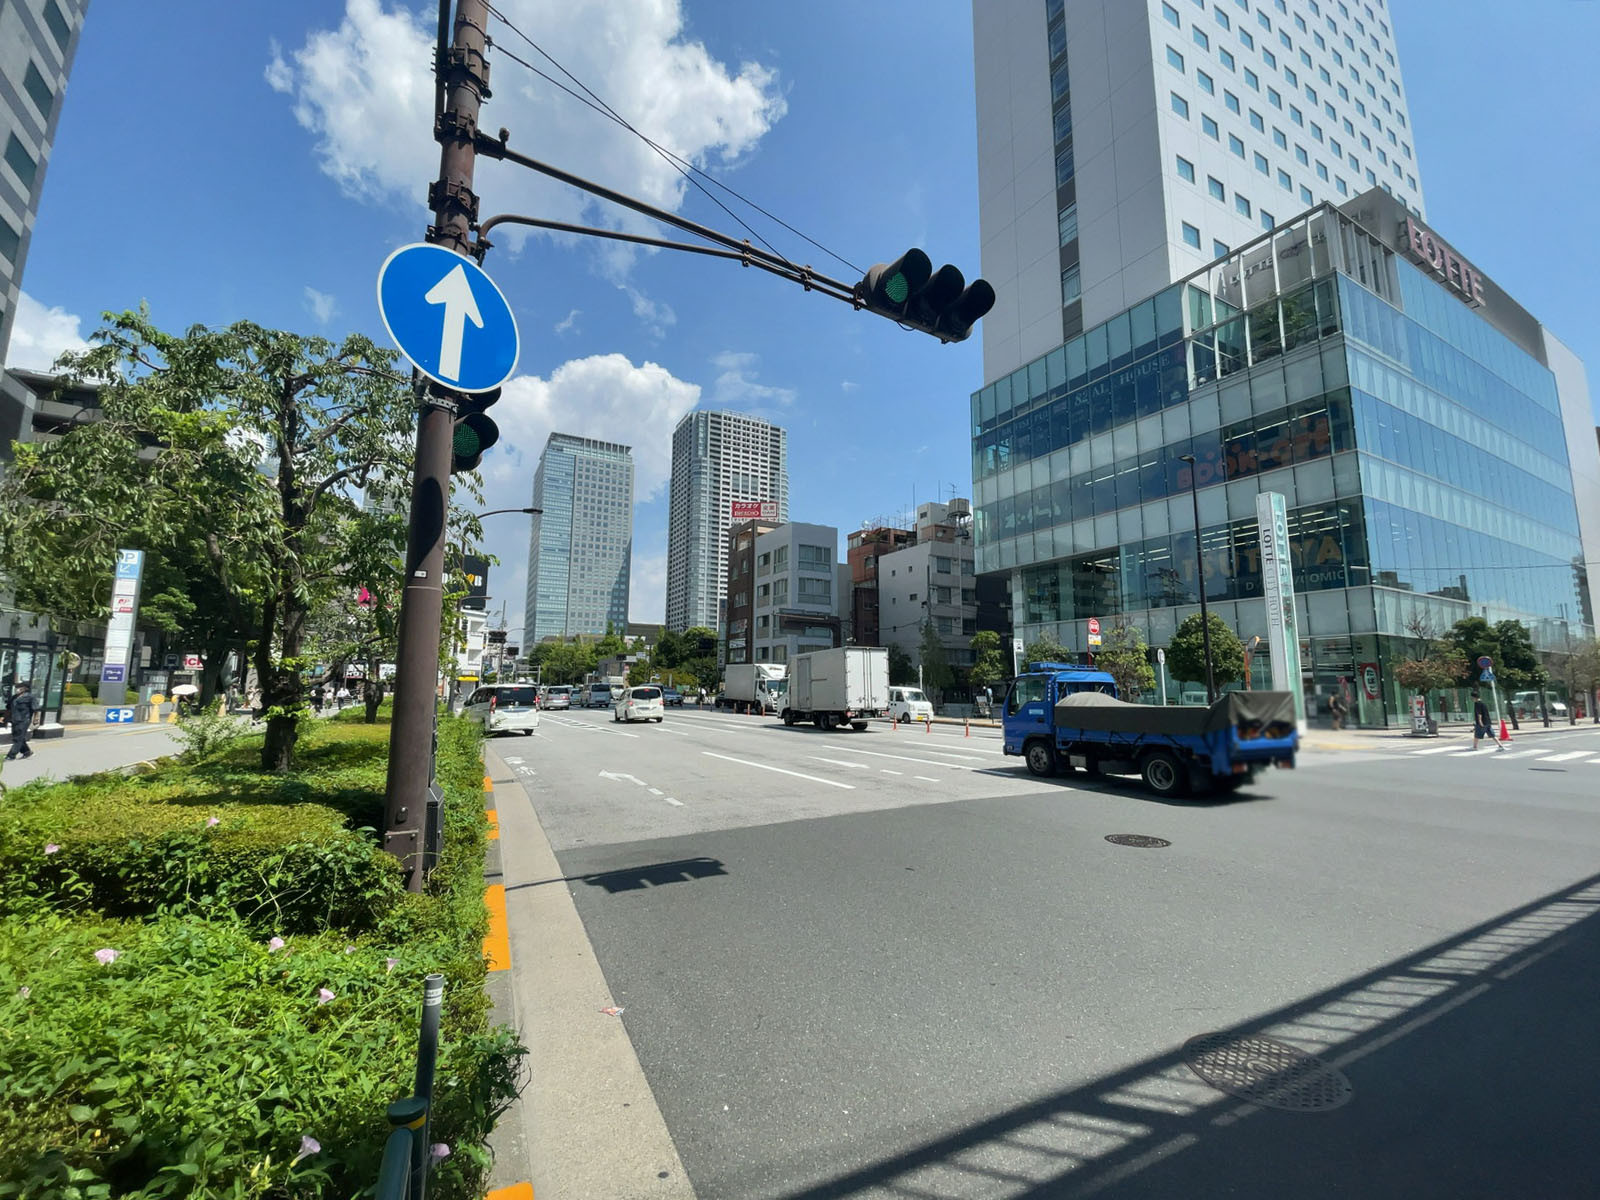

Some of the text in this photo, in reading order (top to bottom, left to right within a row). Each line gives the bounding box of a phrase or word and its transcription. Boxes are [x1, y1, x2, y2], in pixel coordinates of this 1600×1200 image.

[1229, 257, 1273, 287] LOTTE
[1407, 215, 1486, 306] LOTTE
[1120, 353, 1170, 385] HOUSE
[125, 552, 135, 562] P
[1182, 534, 1343, 583] TSUTYA
[1263, 528, 1274, 565] LOTTE
[1269, 596, 1280, 627] HOTEL
[1366, 669, 1377, 693] たばこ
[119, 709, 133, 722] P
